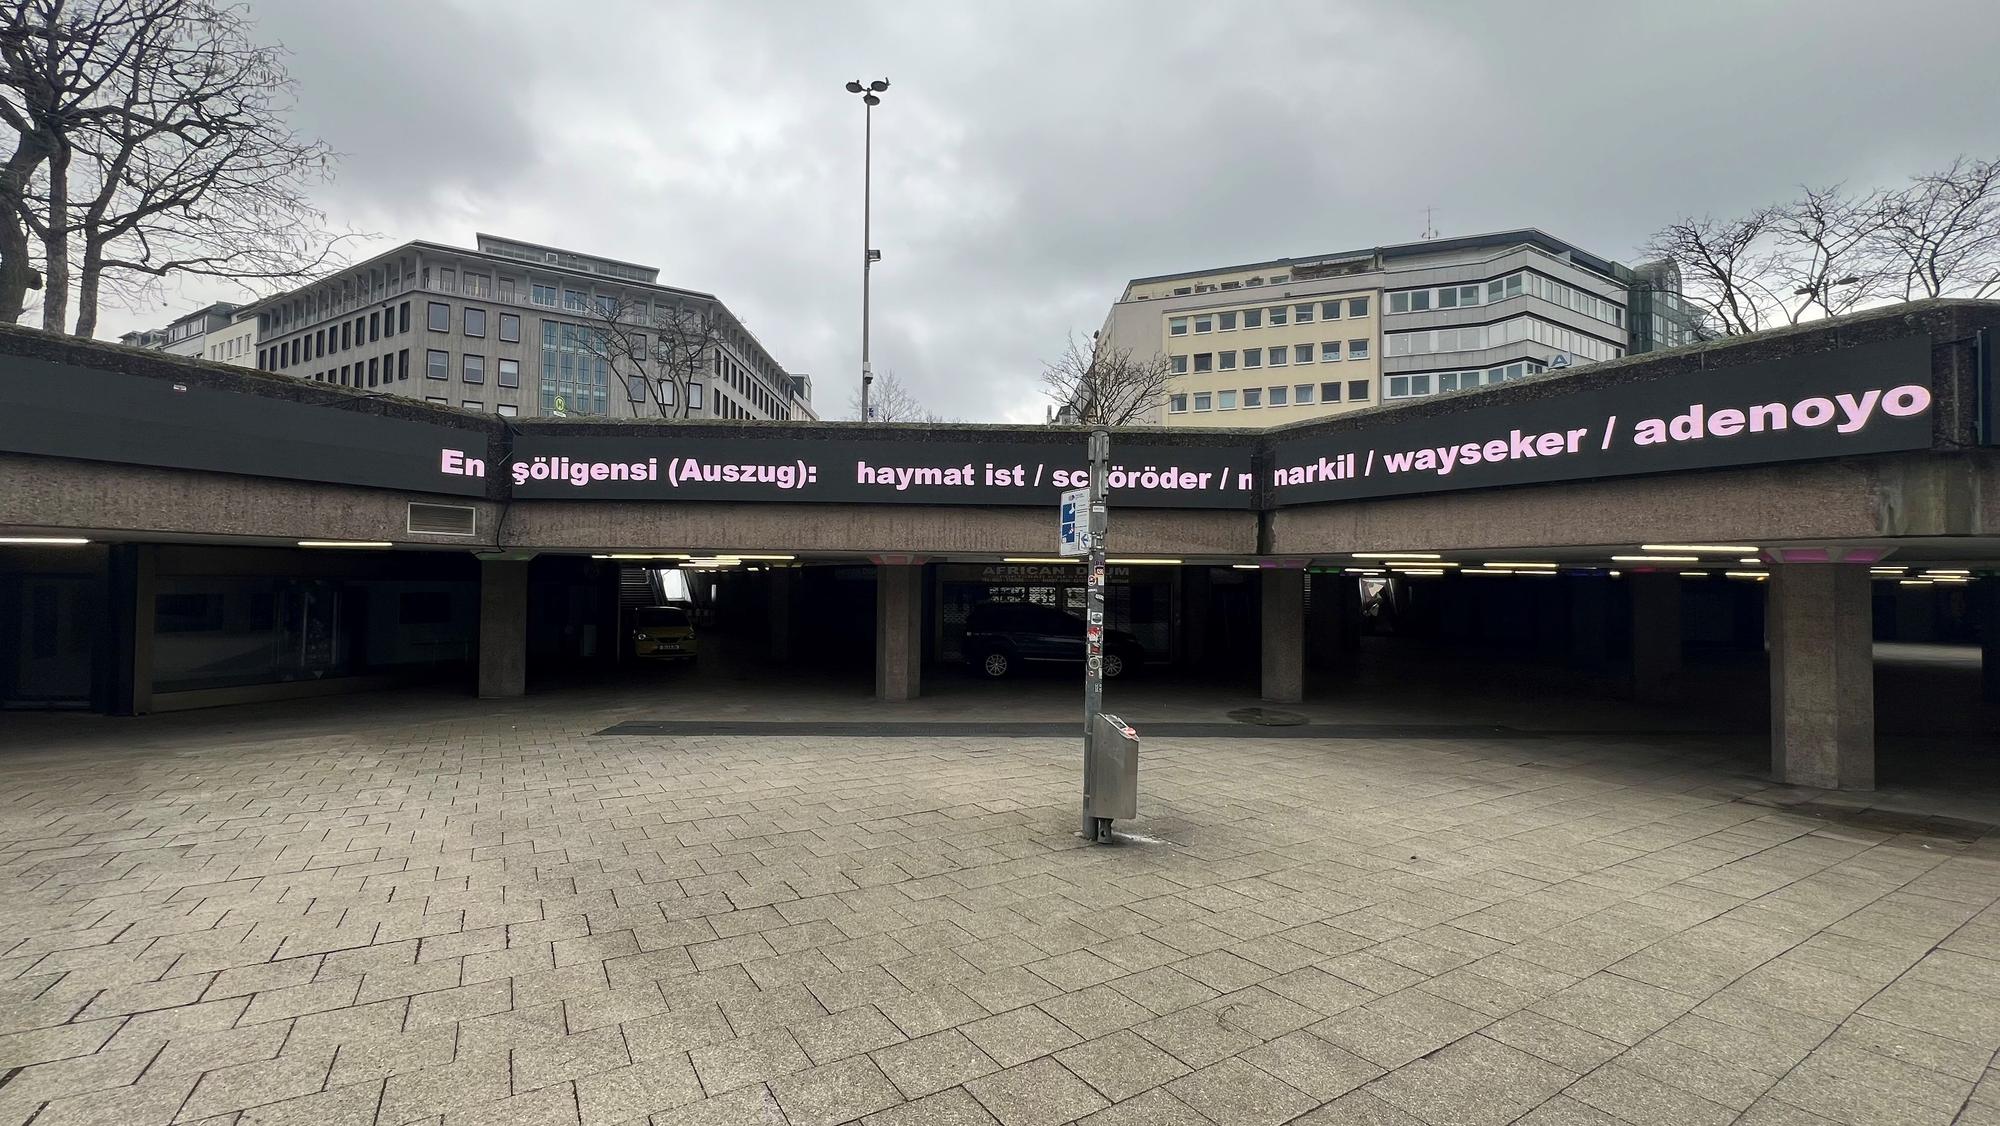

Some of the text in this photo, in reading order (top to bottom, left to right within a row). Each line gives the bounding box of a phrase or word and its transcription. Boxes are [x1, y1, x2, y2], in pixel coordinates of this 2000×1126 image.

[441, 448, 485, 478] En
[512, 456, 657, 487] şöligensi
[668, 458, 818, 489] (Auszug):
[857, 461, 975, 491] haymat
[985, 463, 1025, 487] ist
[1053, 465, 1211, 490] scöröder
[1384, 428, 1588, 476] wayseker
[1633, 385, 1931, 446] adenoyo
[982, 566, 1065, 575] AFRICAN
